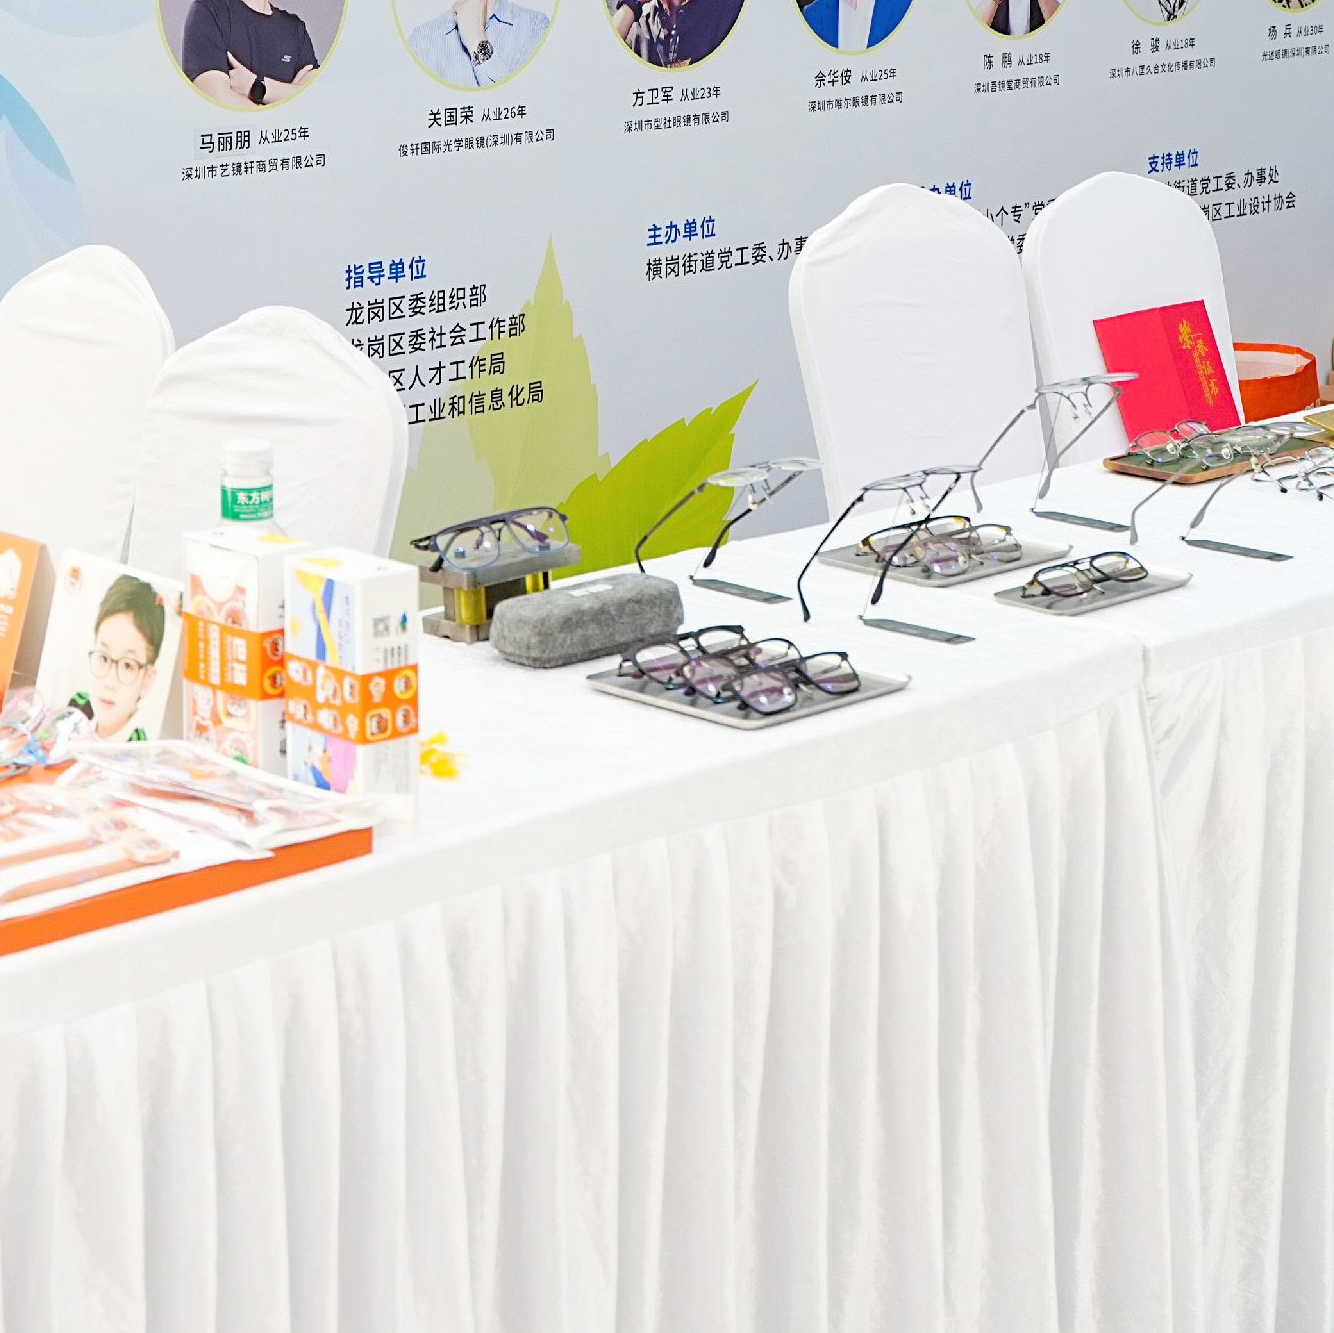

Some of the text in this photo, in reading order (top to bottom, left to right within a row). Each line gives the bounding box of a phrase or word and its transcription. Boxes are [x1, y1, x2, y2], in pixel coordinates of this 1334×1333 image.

[1017, 52, 1051, 66] 从业18年
[860, 68, 897, 83] 从业25年
[632, 85, 721, 107] 方卫军 从业23年
[428, 105, 527, 128] 关国荣 从业26年
[199, 126, 310, 154] 马丽朋 从业25年
[182, 154, 326, 182] 深圳市艺镜轩商贸有限公司
[1148, 148, 1199, 174] 支持单位
[1167, 165, 1279, 197] 街道党工委、办事处
[647, 215, 716, 247] 主办单位
[345, 255, 427, 290] 指导单位
[345, 284, 487, 327] 龙岗区委组织部
[404, 381, 544, 425] 工业和信息化局
